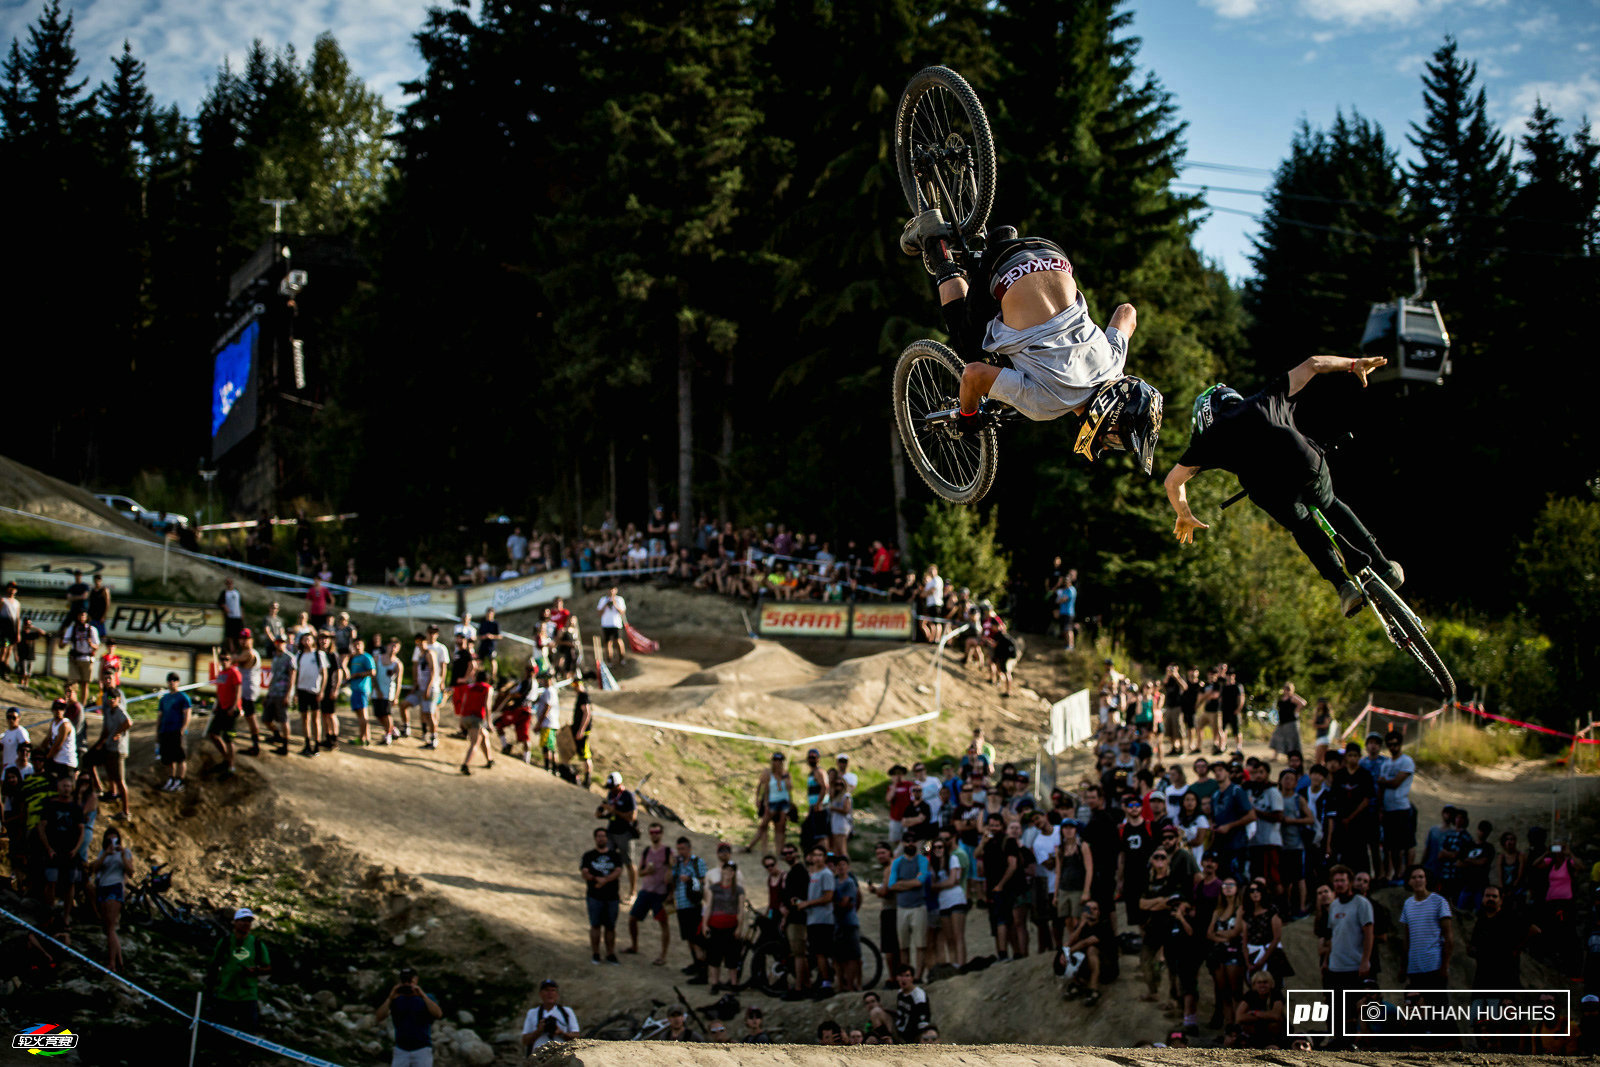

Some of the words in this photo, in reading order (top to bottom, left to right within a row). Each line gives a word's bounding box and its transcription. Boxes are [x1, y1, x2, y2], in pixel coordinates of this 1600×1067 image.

[898, 94, 911, 140] BONTRAGER
[1111, 401, 1125, 425] SMITH
[110, 606, 169, 634] FOX
[765, 611, 842, 629] SRAM
[855, 613, 906, 630] SRAM
